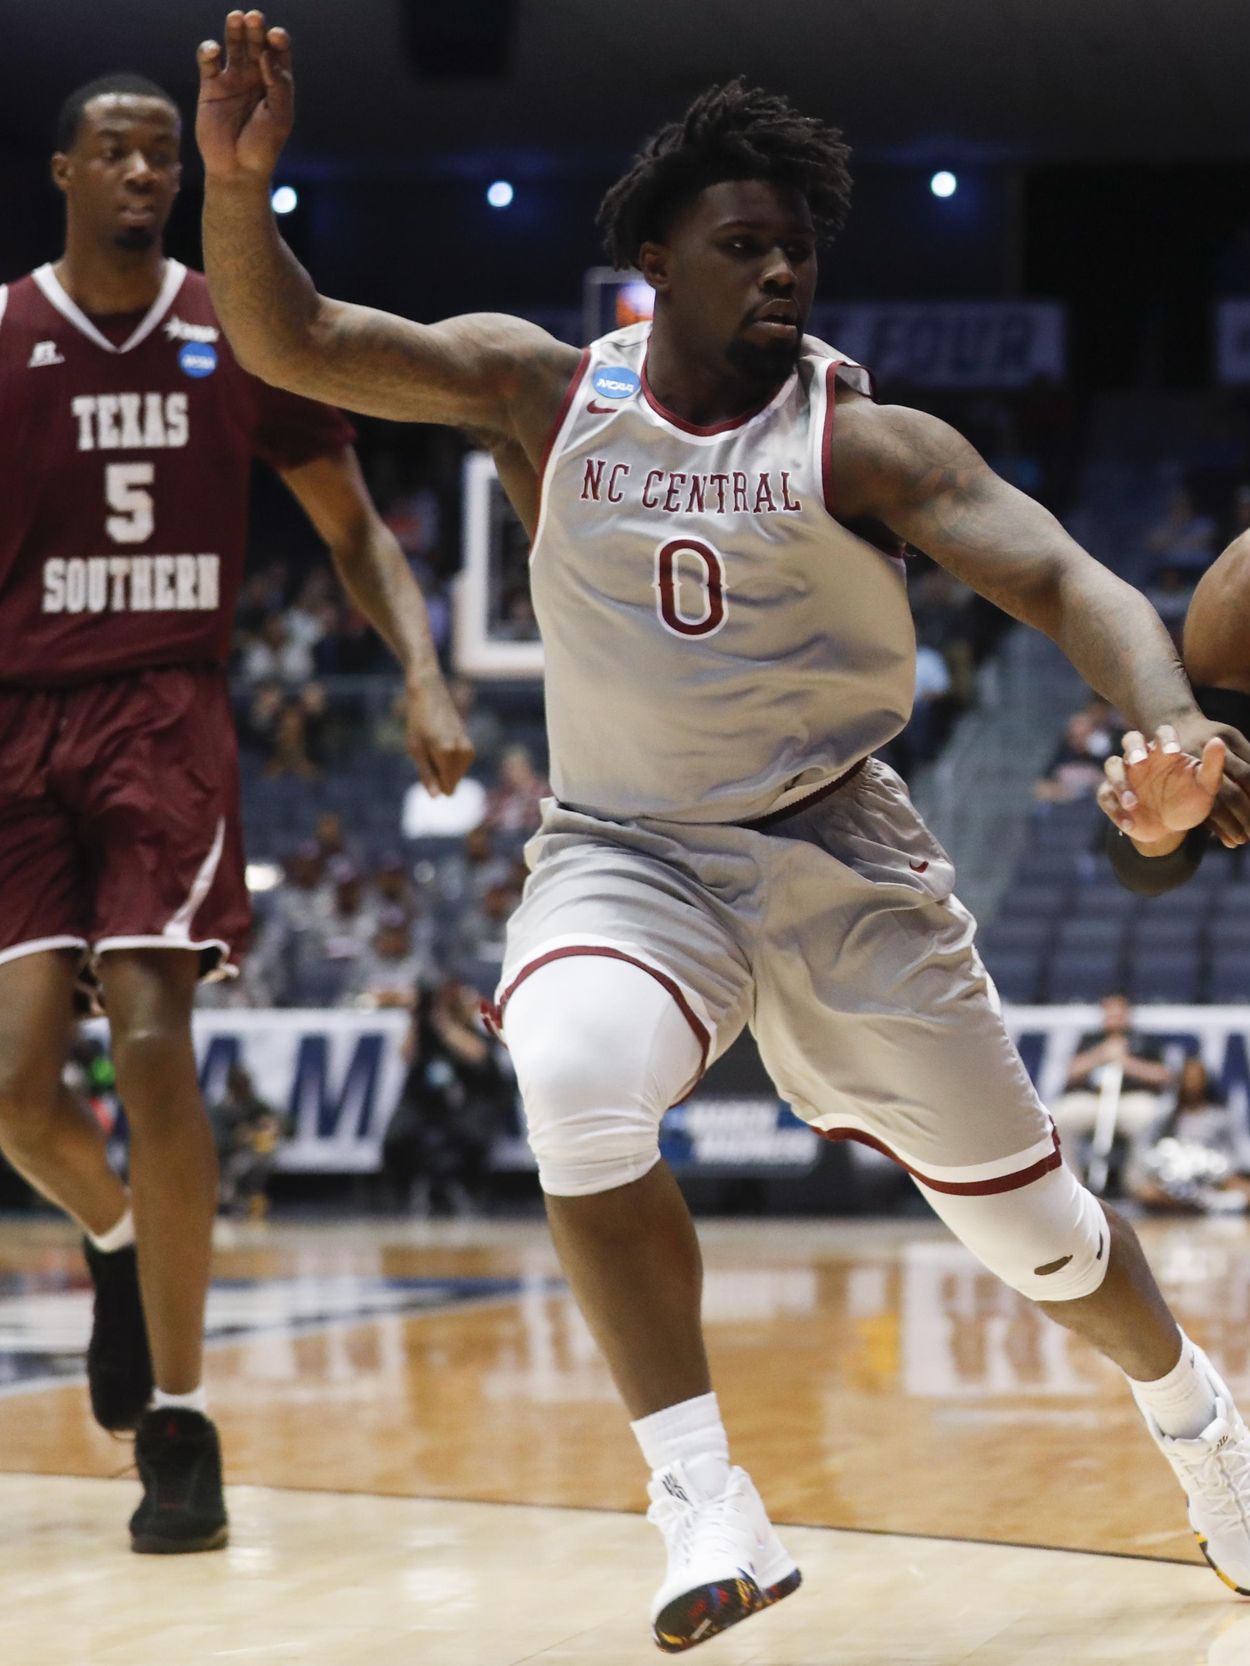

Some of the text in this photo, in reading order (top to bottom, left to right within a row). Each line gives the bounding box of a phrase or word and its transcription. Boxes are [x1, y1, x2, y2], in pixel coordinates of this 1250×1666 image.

[596, 378, 635, 392] NCAA
[71, 392, 189, 452] TEXAS
[105, 462, 155, 544] 5
[580, 457, 802, 514] NC CENTRAL
[42, 553, 221, 614] SOUTHERN
[653, 535, 730, 640] 0
